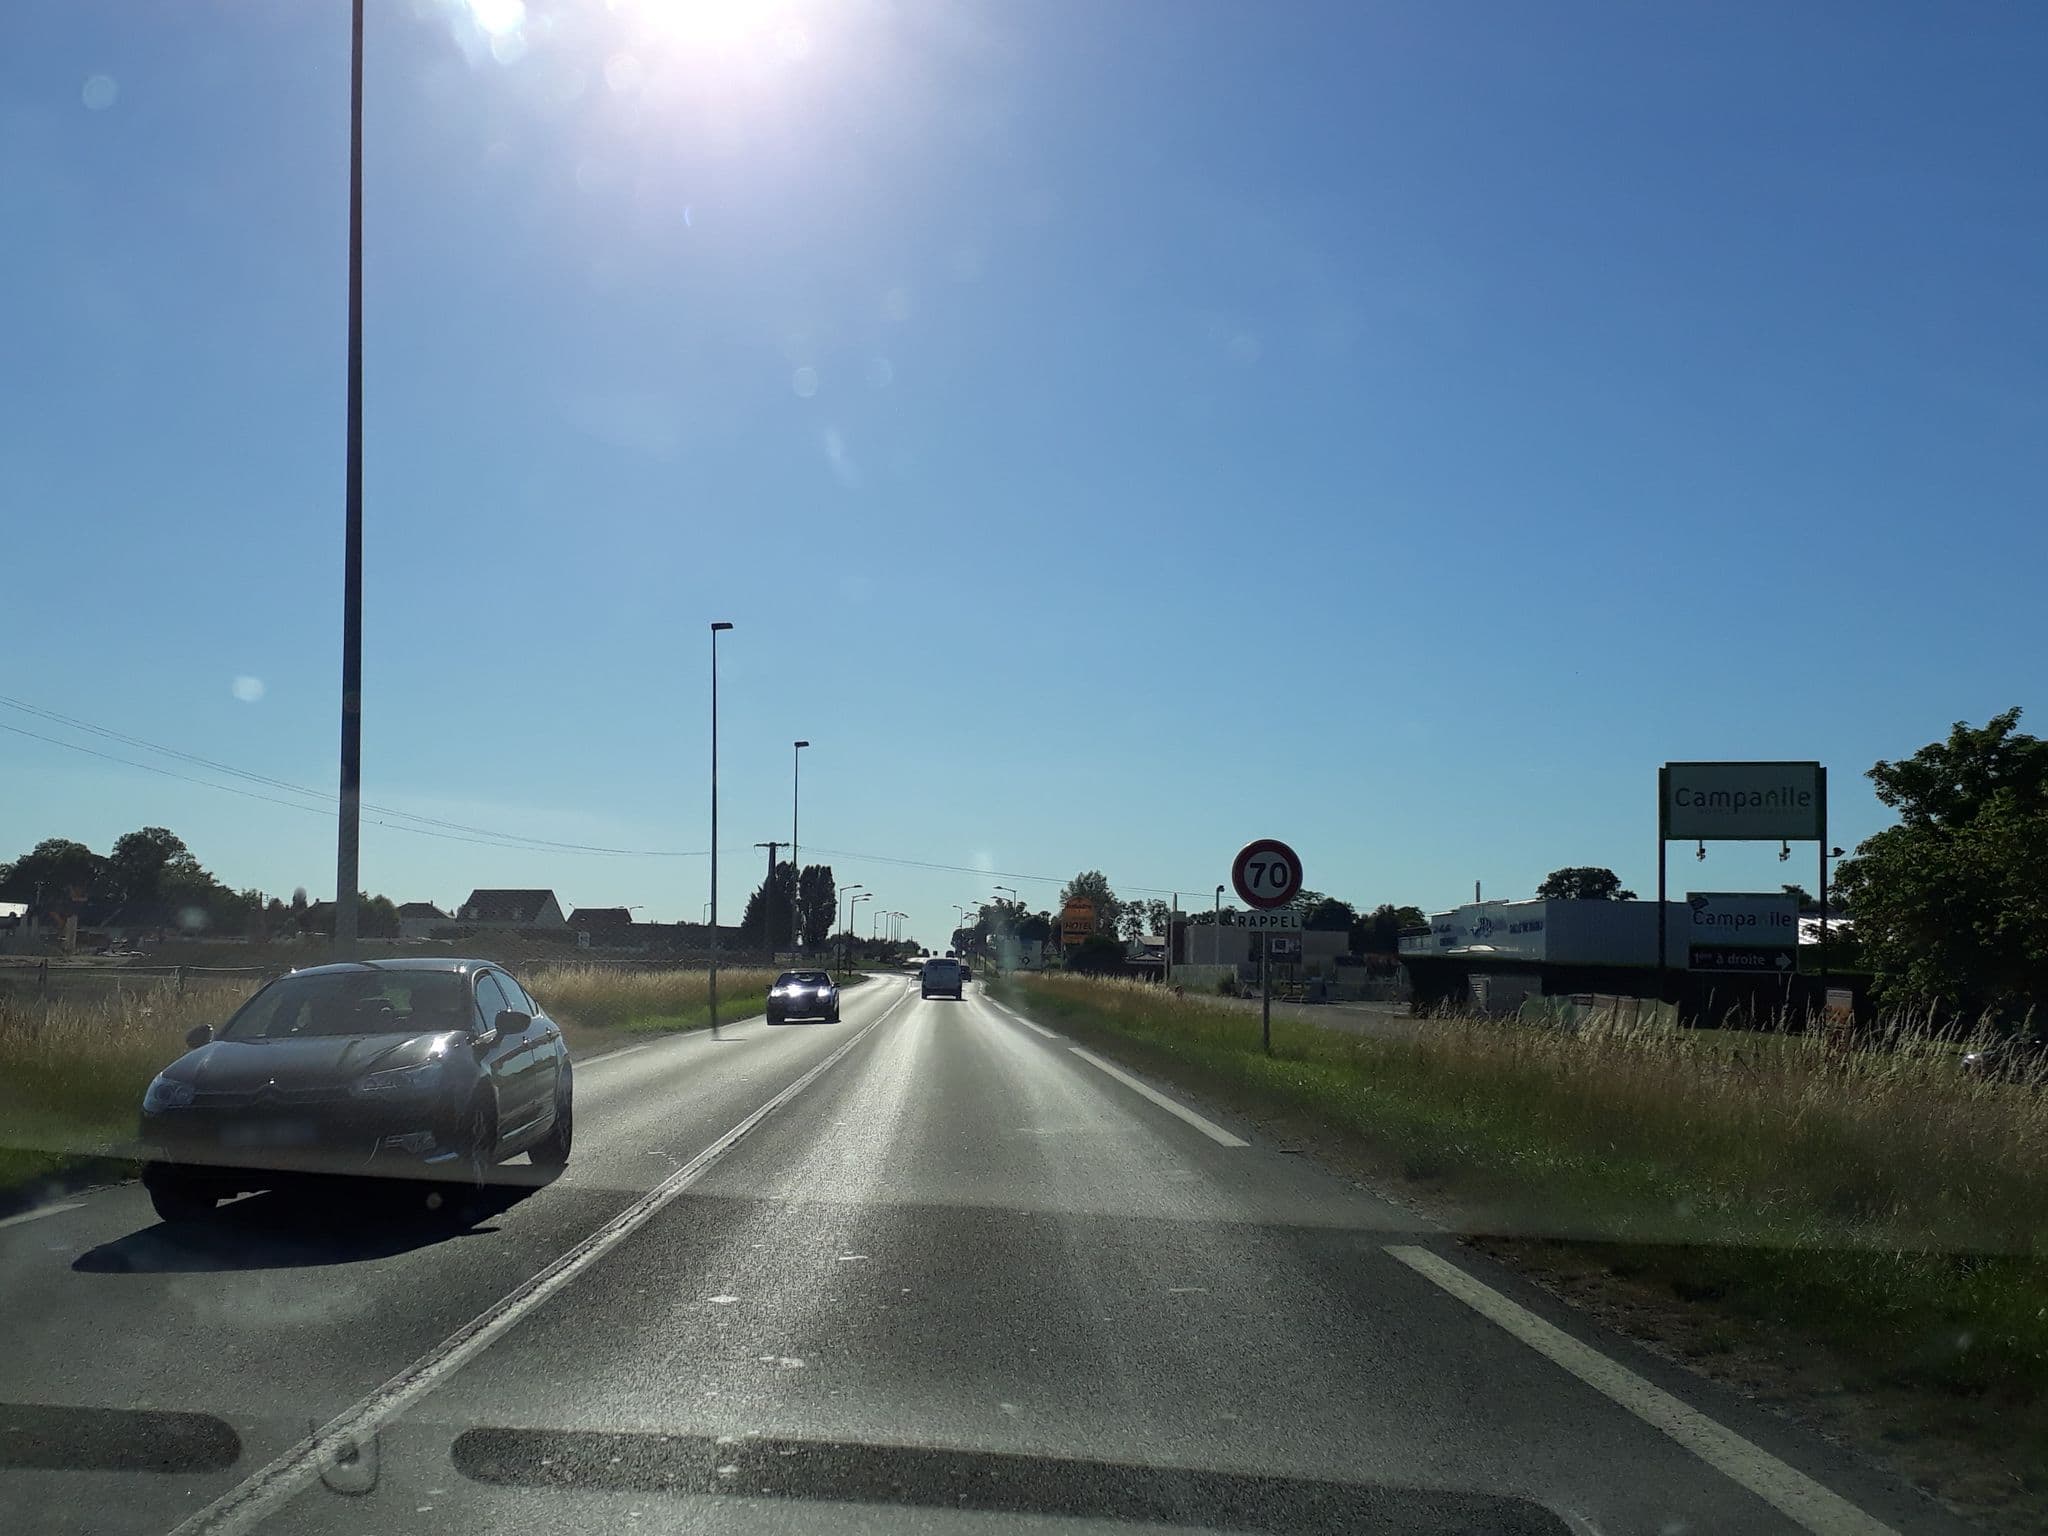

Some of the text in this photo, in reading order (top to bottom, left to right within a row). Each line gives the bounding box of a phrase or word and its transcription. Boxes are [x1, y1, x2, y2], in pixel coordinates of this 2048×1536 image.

[1675, 786, 1811, 814] Campanile
[1249, 862, 1288, 889] 70
[1064, 920, 1093, 930] HOTEL
[1238, 915, 1299, 928] RAPPEL
[1693, 910, 1792, 932] Campaile
[1727, 952, 1766, 966] droite
